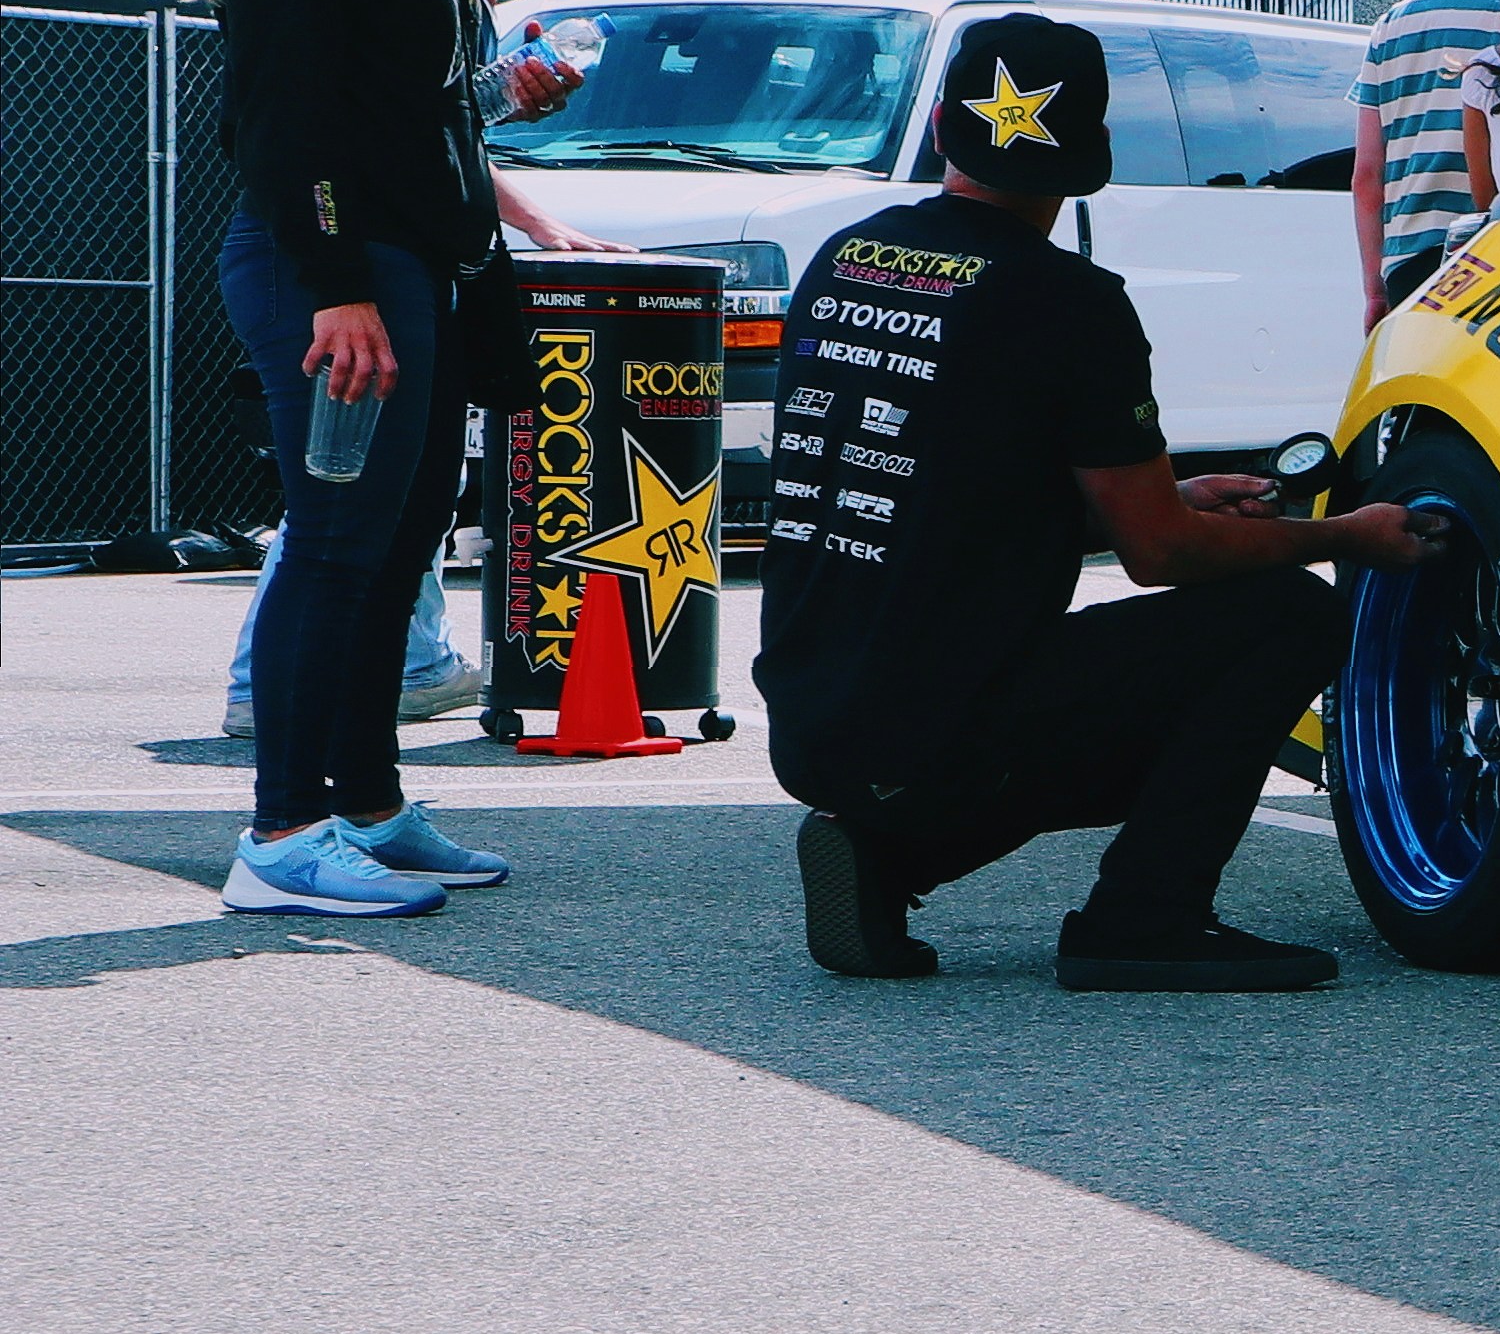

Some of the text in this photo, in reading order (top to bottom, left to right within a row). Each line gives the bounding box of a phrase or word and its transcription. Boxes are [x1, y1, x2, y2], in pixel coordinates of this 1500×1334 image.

[837, 262, 954, 295] ENERGY DRINK
[531, 292, 703, 310] TAURINE B-VITAMINS
[838, 300, 942, 342] TOYOTA
[817, 339, 883, 368] NEXEN
[886, 352, 938, 381] TIRE
[626, 363, 724, 396] ROCKS
[641, 399, 709, 416] ENERGY
[883, 455, 916, 477] OIL
[535, 333, 591, 666] ROCKSAR
[775, 479, 823, 499] BERK
[846, 490, 896, 517] EFR
[774, 518, 818, 536] PC
[509, 524, 533, 638] DRINK
